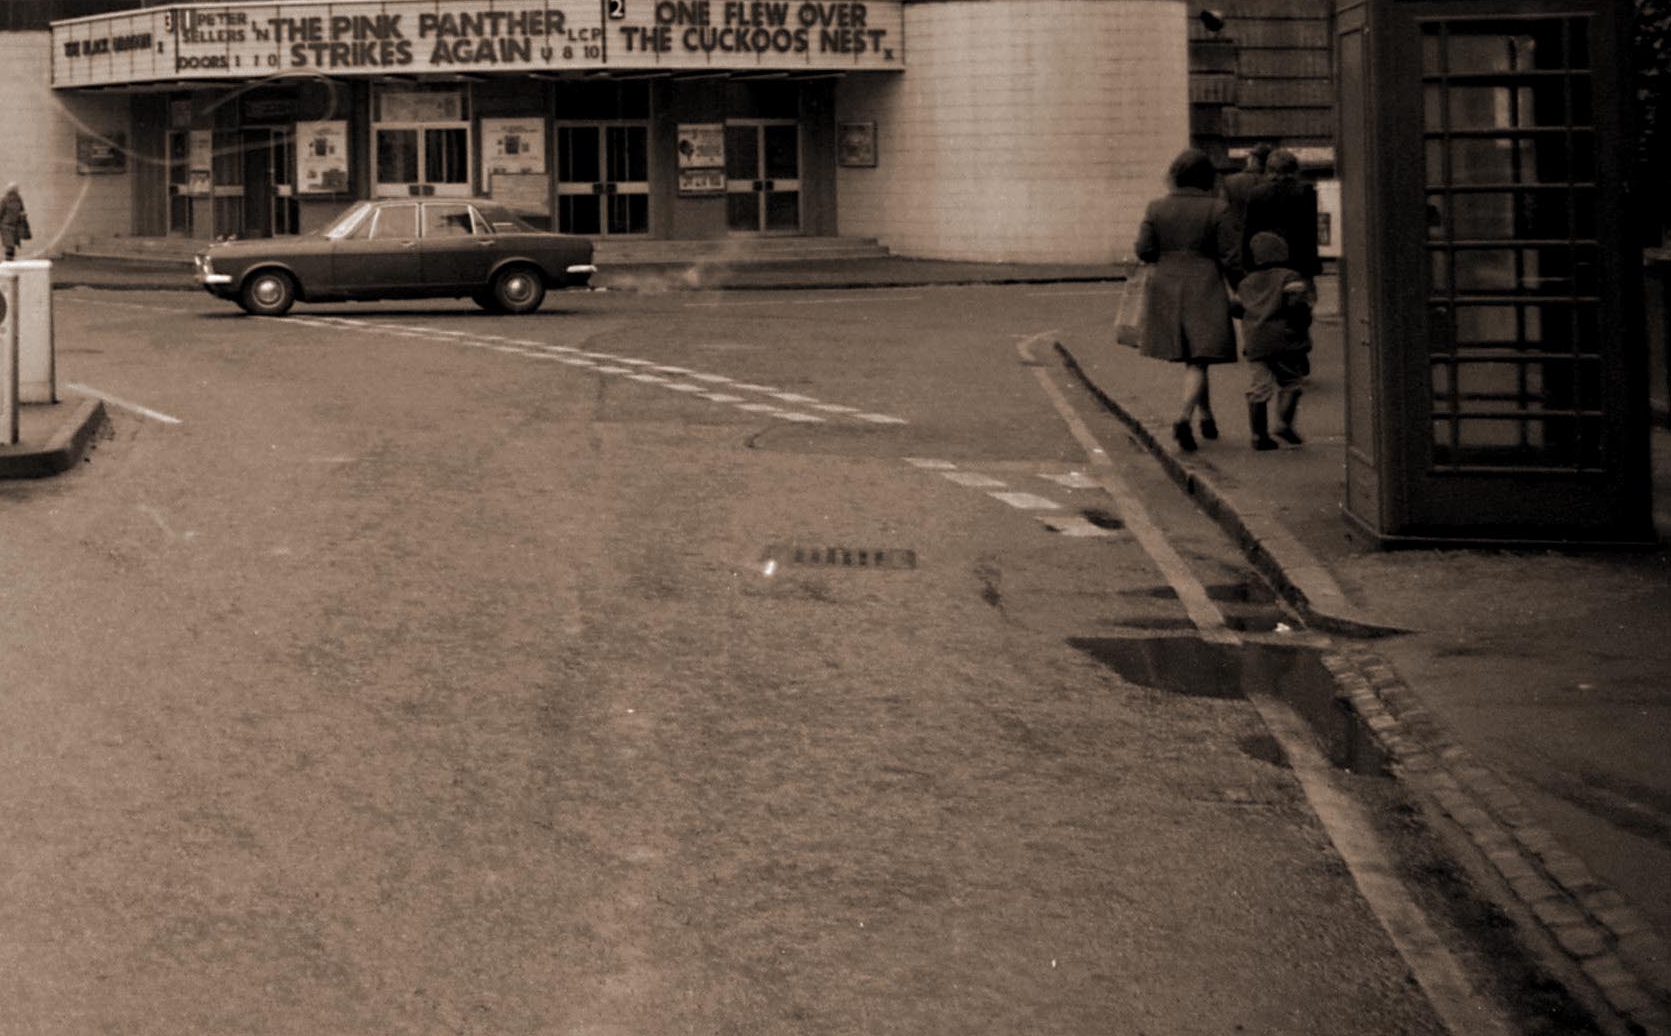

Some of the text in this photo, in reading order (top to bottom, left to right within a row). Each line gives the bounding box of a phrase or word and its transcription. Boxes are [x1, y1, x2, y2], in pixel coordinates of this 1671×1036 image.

[197, 12, 247, 27] PETER
[267, 10, 566, 43] THE PINK PANTHER
[655, 0, 868, 29] ONE FLEW OVER
[183, 29, 246, 43] SELLERS
[619, 26, 673, 52] THE
[682, 27, 809, 54] CUCKOOS
[820, 29, 887, 54] NEST
[178, 56, 229, 70] DOORS
[291, 40, 413, 67] STRIKES
[430, 38, 531, 65] AGAIN
